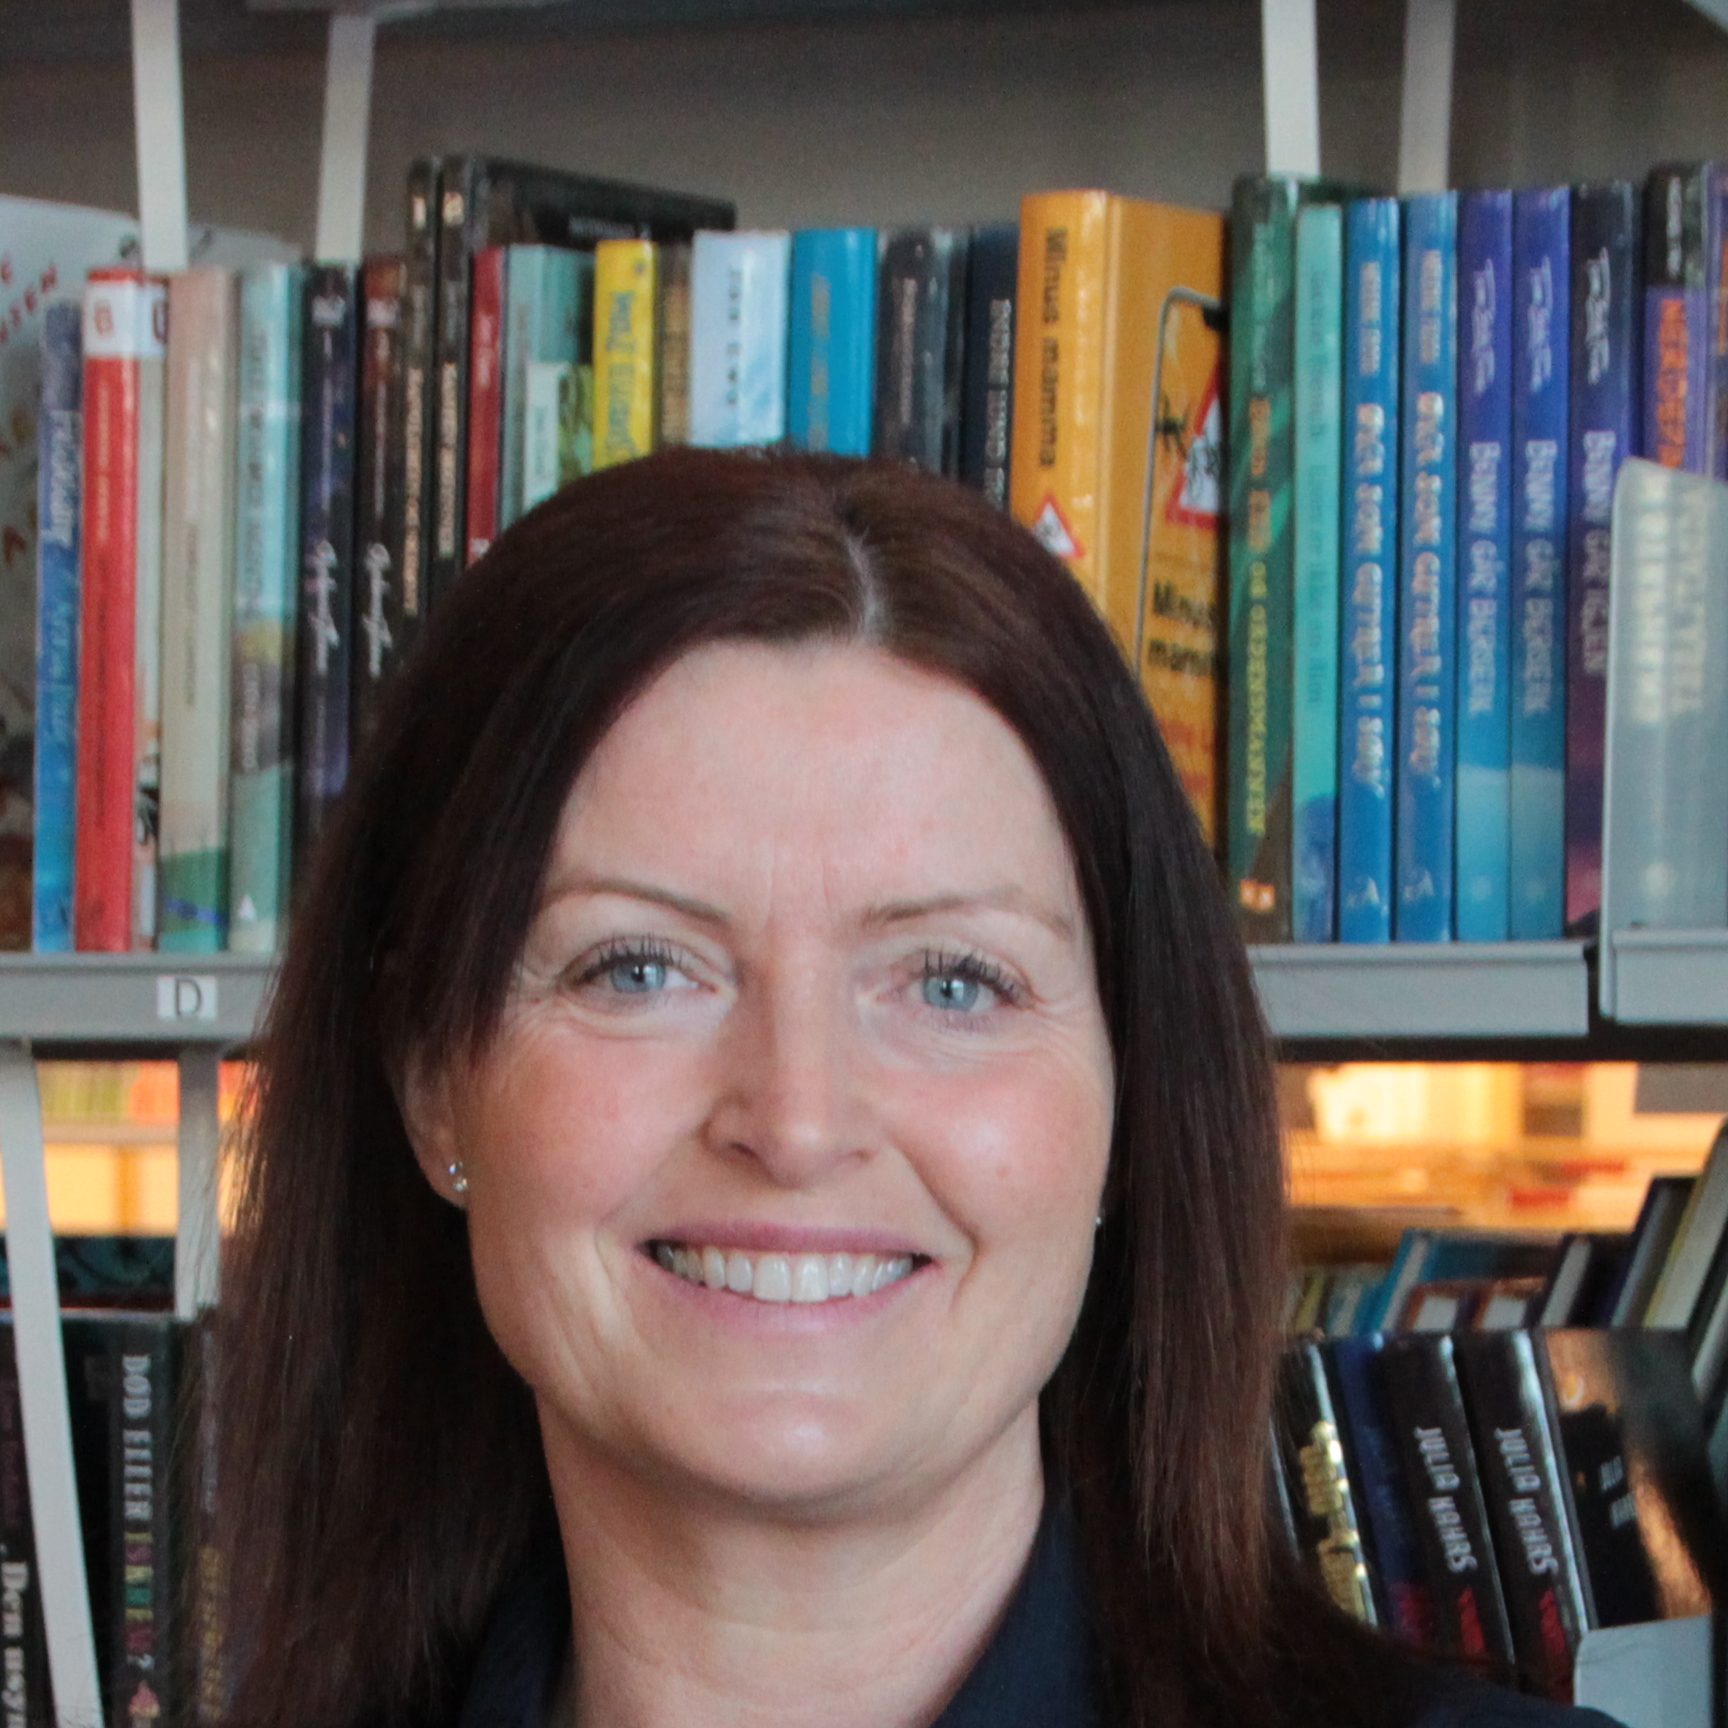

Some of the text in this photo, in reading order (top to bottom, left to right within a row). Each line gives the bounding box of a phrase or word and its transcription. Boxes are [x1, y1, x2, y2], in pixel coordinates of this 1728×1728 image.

[1038, 227, 1069, 470] Minus mamma
[1469, 440, 1501, 532] BENNY
[1524, 439, 1558, 533] BENNY
[1581, 430, 1618, 522] BENNY
[174, 976, 203, 1018] D
[1412, 1425, 1479, 1576] JULIA KAHRS
[1493, 1425, 1561, 1578] JULIA KAHRS
[0, 1560, 29, 1634] Den
